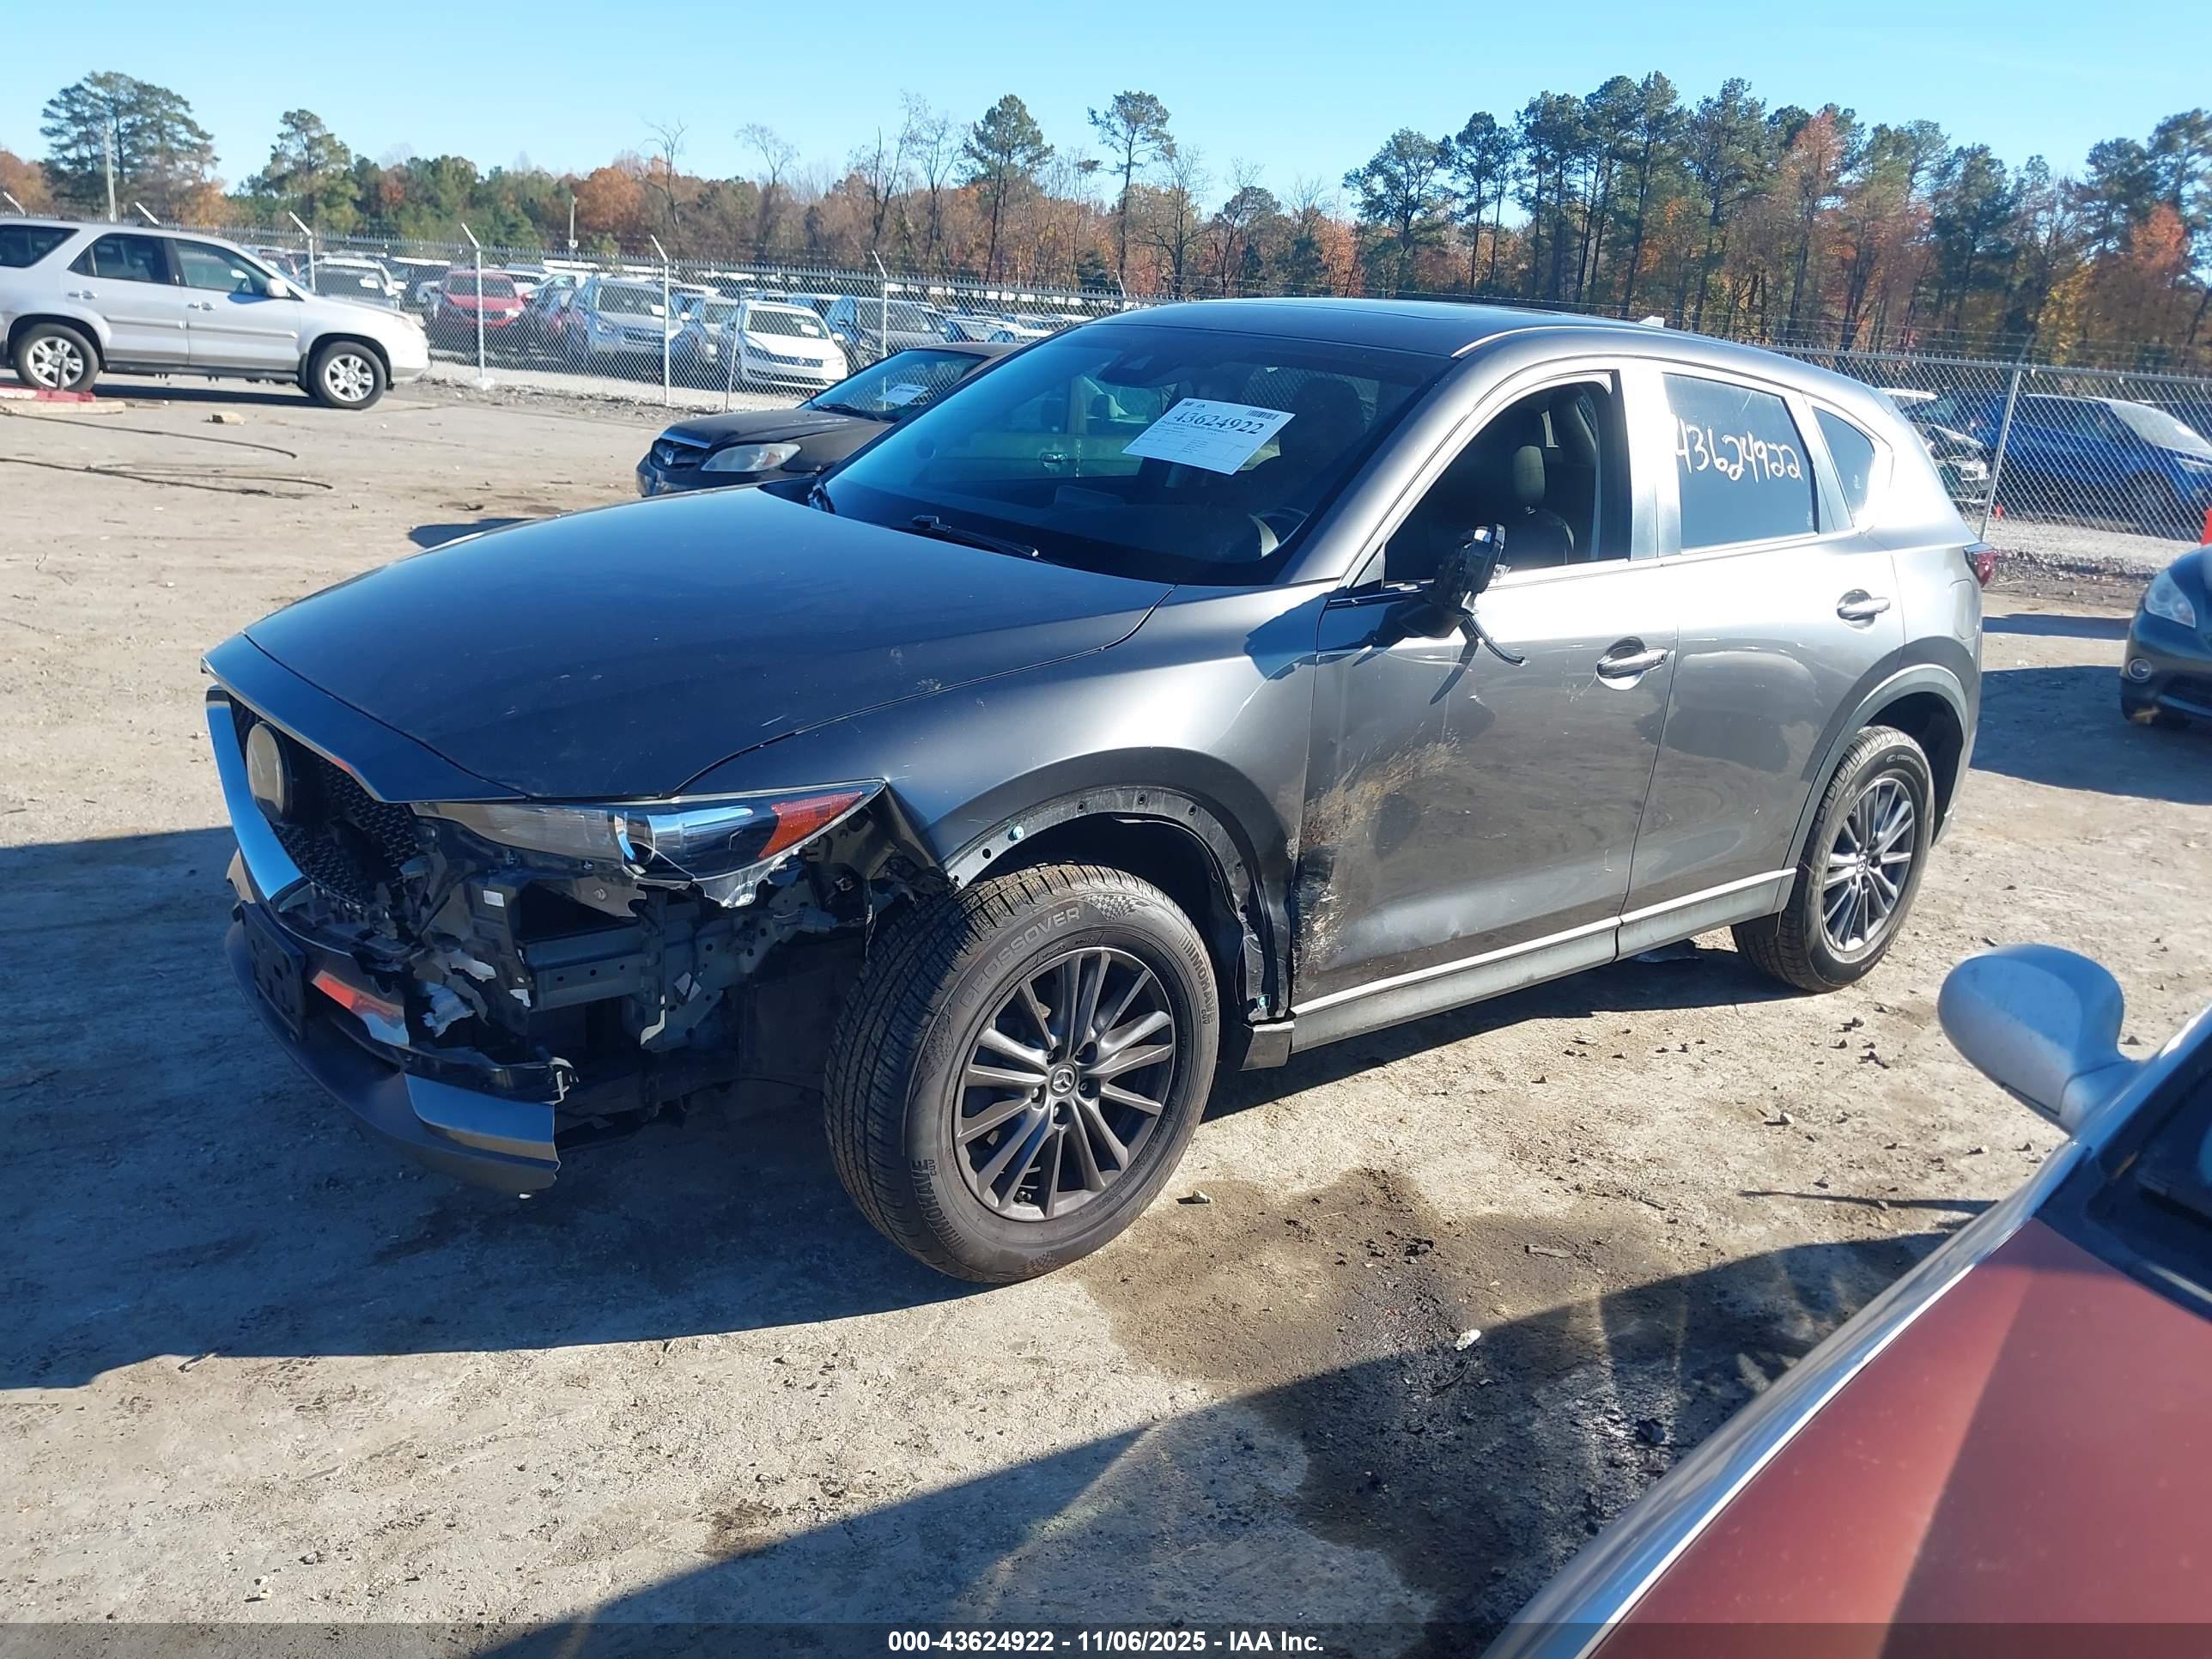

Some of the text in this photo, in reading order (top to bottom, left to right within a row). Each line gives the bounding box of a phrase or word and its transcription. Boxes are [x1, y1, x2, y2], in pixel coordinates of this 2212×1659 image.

[1175, 411, 1265, 434] 43624922
[1675, 418, 1802, 483] 43624922
[959, 907, 1080, 1008] CROSSOVER
[1201, 1009, 1211, 1024] CUV
